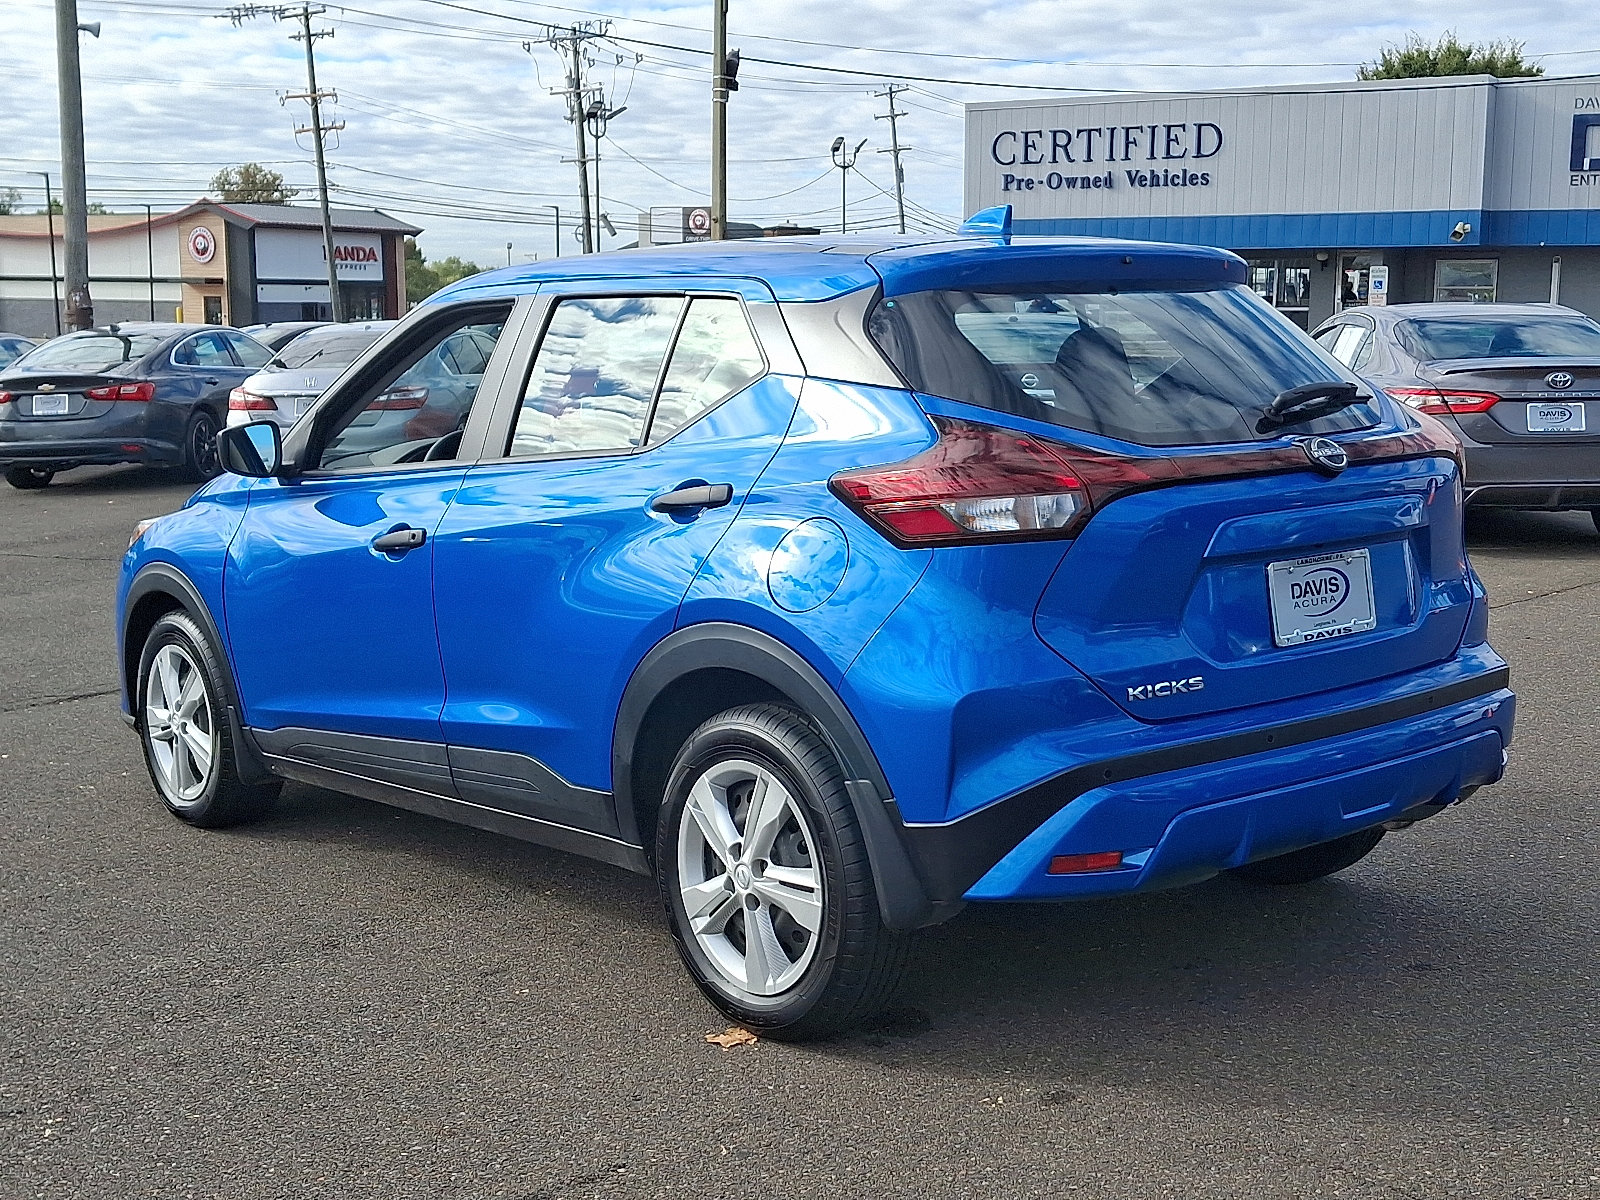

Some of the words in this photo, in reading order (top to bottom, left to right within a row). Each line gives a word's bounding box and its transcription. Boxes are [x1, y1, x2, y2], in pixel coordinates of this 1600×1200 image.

[991, 122, 1224, 166] CERTIFIED
[1001, 170, 1113, 191] Pre-Owned
[1124, 168, 1210, 188] Vehicles
[1290, 576, 1340, 600] DAVIS
[1293, 595, 1337, 610] ACURA
[1303, 626, 1353, 642] DAVIS
[1126, 676, 1204, 702] KICKS
